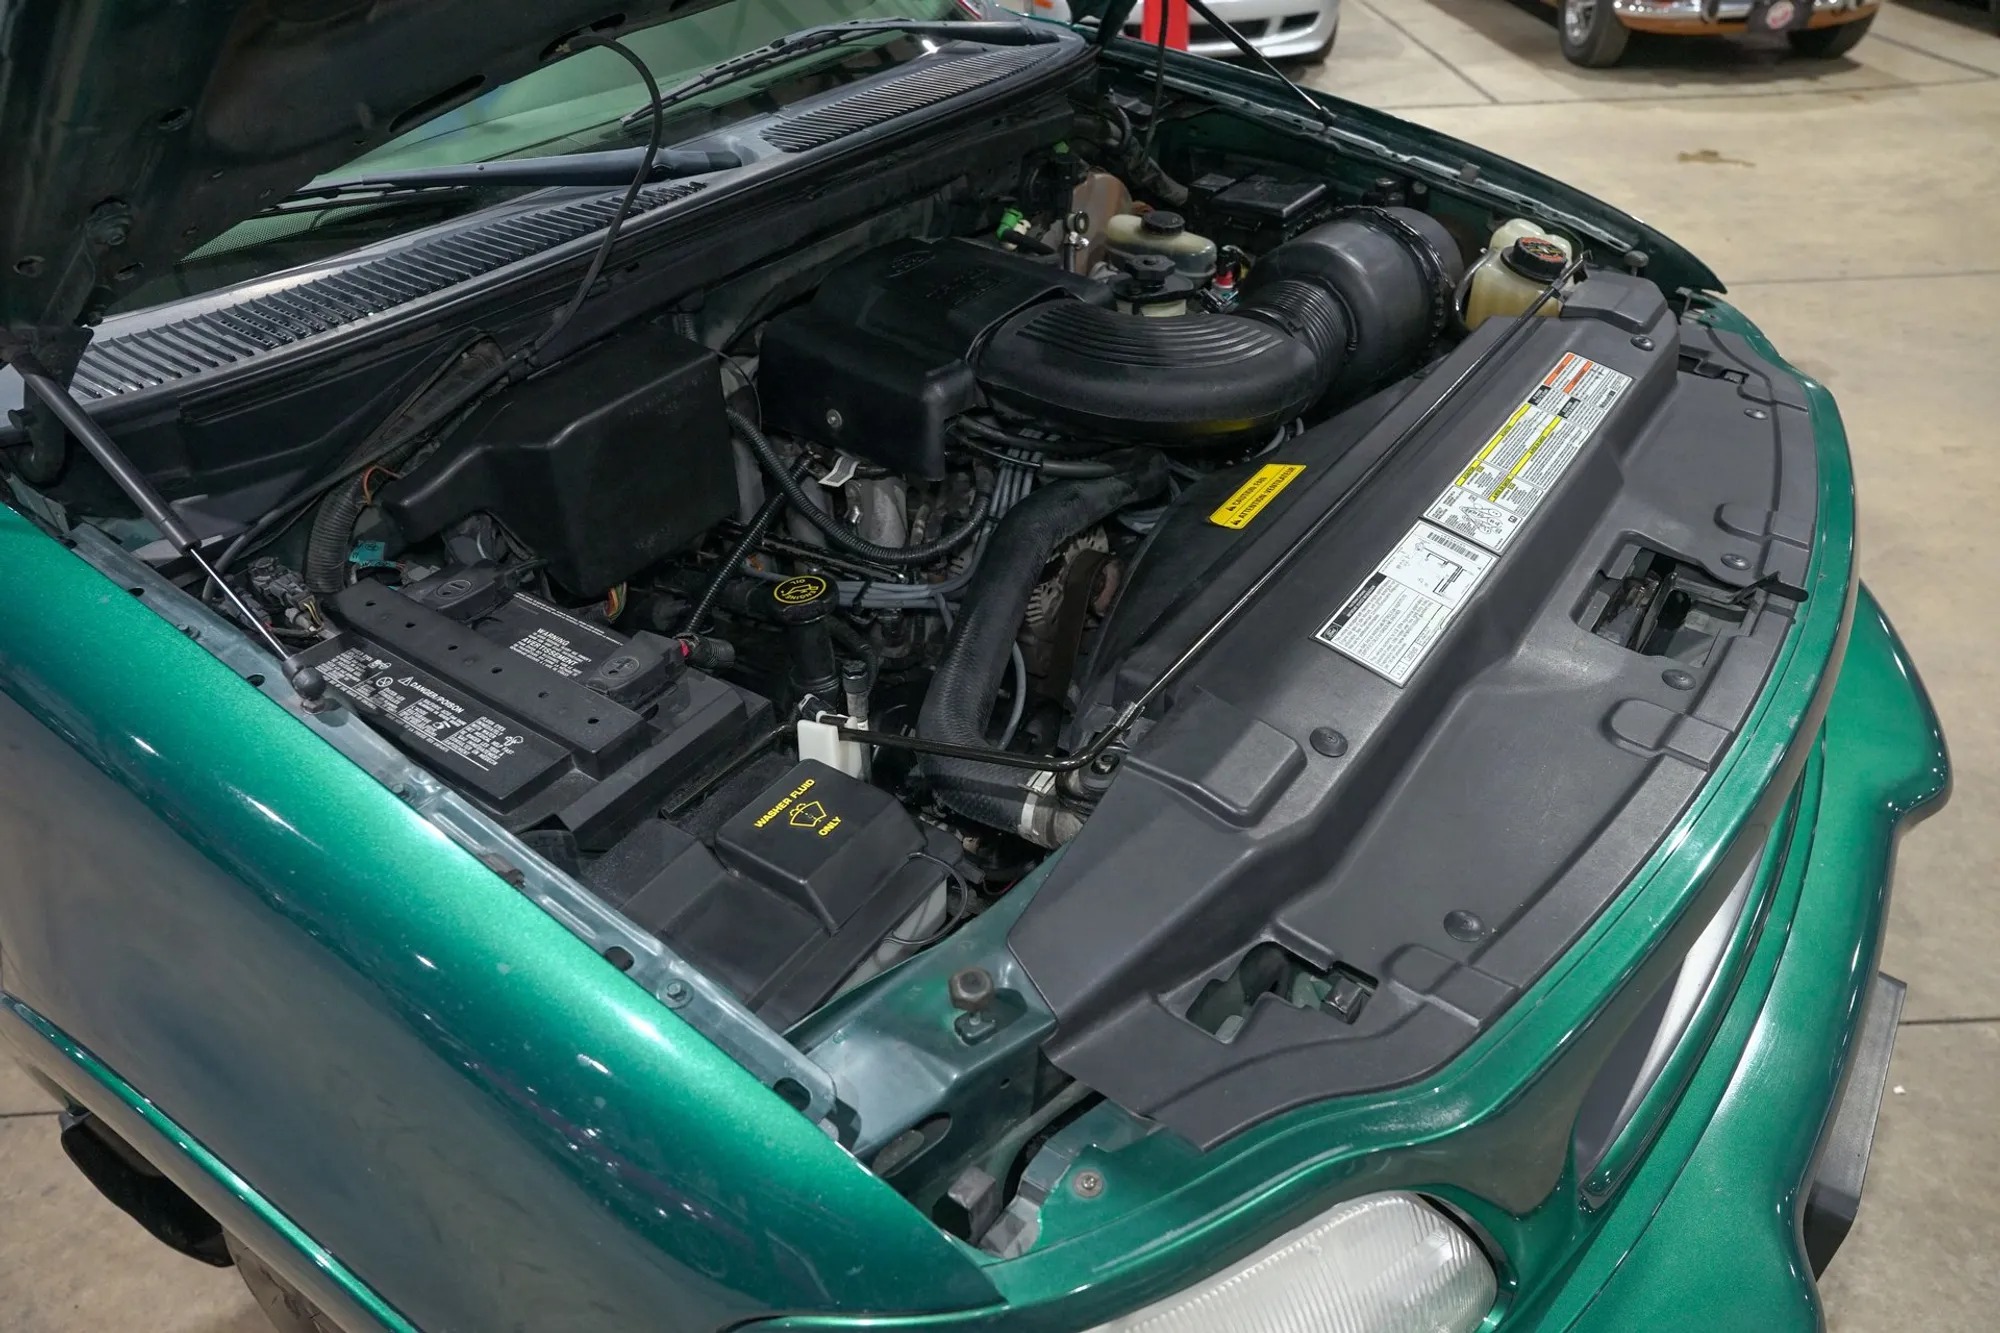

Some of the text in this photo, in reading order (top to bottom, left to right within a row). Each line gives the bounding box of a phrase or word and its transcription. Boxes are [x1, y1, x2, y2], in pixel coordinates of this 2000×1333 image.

[785, 591, 816, 600] ENGINE
[537, 628, 571, 646] WARNING
[520, 637, 579, 666] AVERTISSEMENT
[410, 682, 465, 713] DANGER/POISON
[754, 779, 815, 828] WASHER FLUID
[818, 816, 842, 836] ONLY
